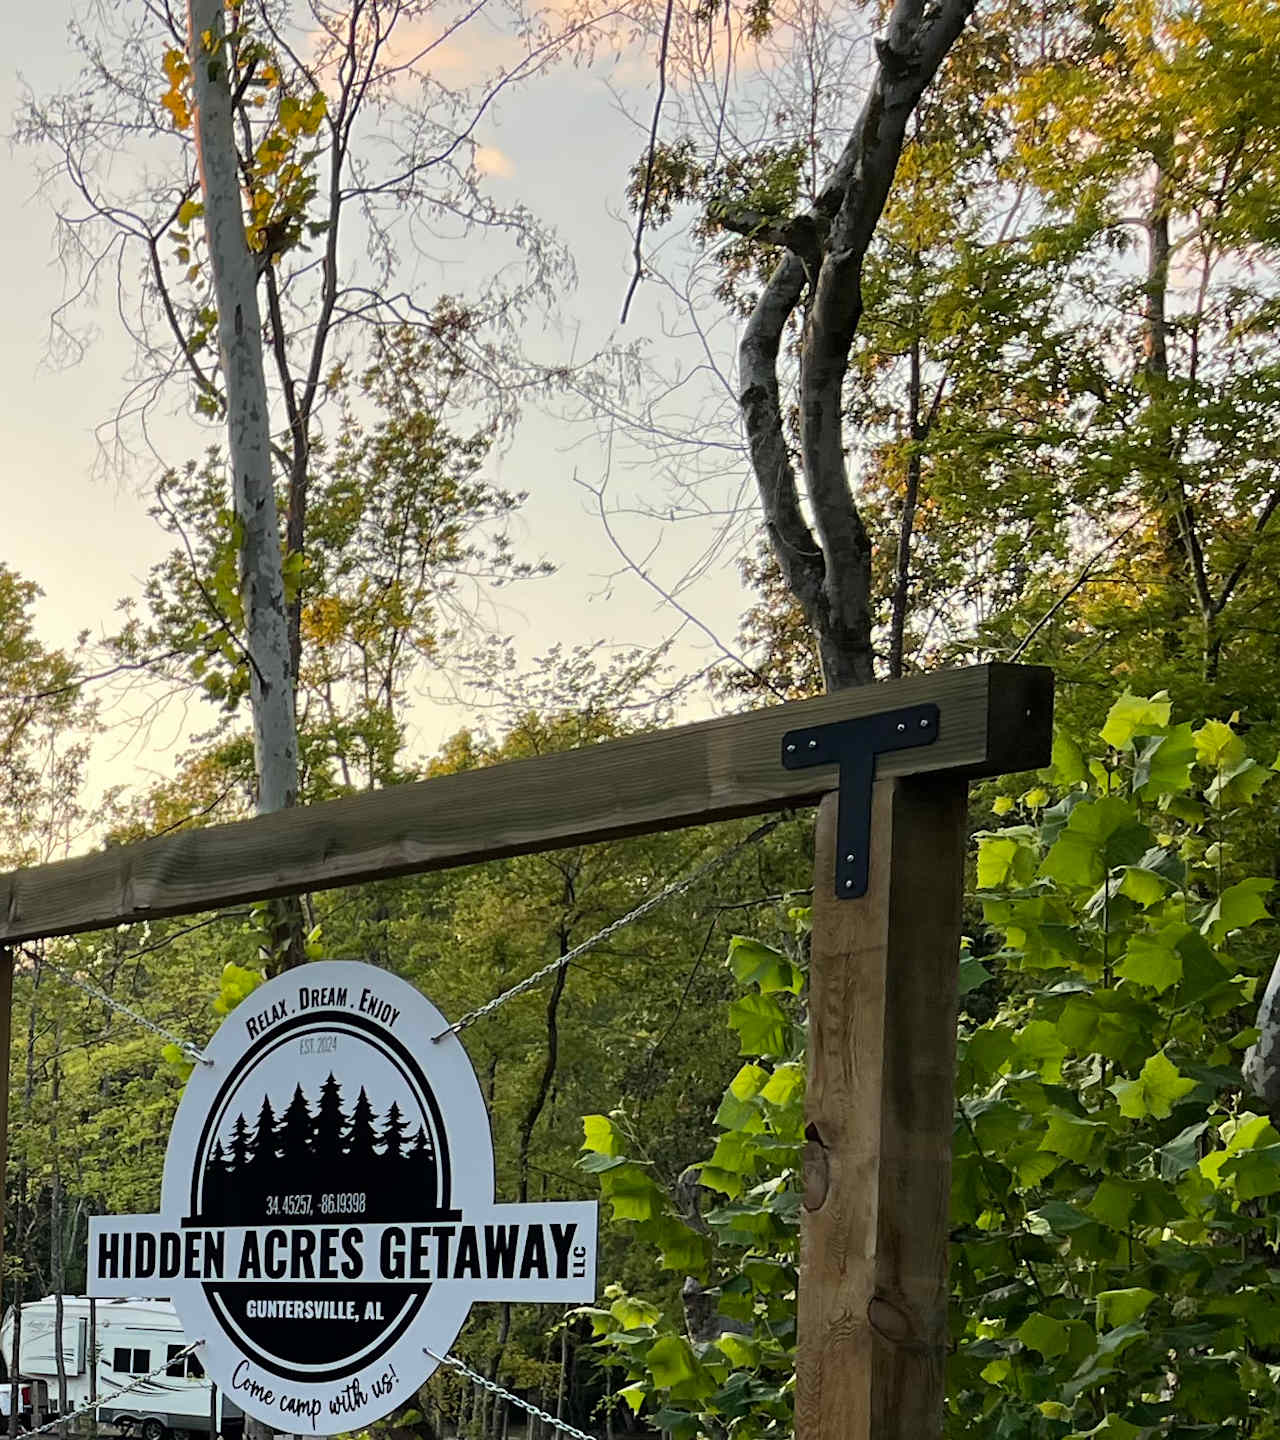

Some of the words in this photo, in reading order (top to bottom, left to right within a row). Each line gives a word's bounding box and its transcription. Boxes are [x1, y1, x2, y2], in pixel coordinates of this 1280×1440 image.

[245, 999, 289, 1041] RELAX
[299, 987, 348, 1011] DREAM
[358, 988, 401, 1028] ENJOY
[317, 1192, 366, 1215] -86.19398
[97, 1230, 225, 1279] HIDDEN
[238, 1228, 364, 1280] ACRES
[379, 1223, 578, 1280] GETAWAY
[573, 1245, 587, 1279] LLC
[245, 1299, 360, 1323] GUNTERSVILLE,
[363, 1300, 385, 1321] AL
[231, 1359, 276, 1405] Come
[279, 1395, 322, 1431] camp
[329, 1377, 369, 1416] with
[371, 1363, 400, 1399] us!
